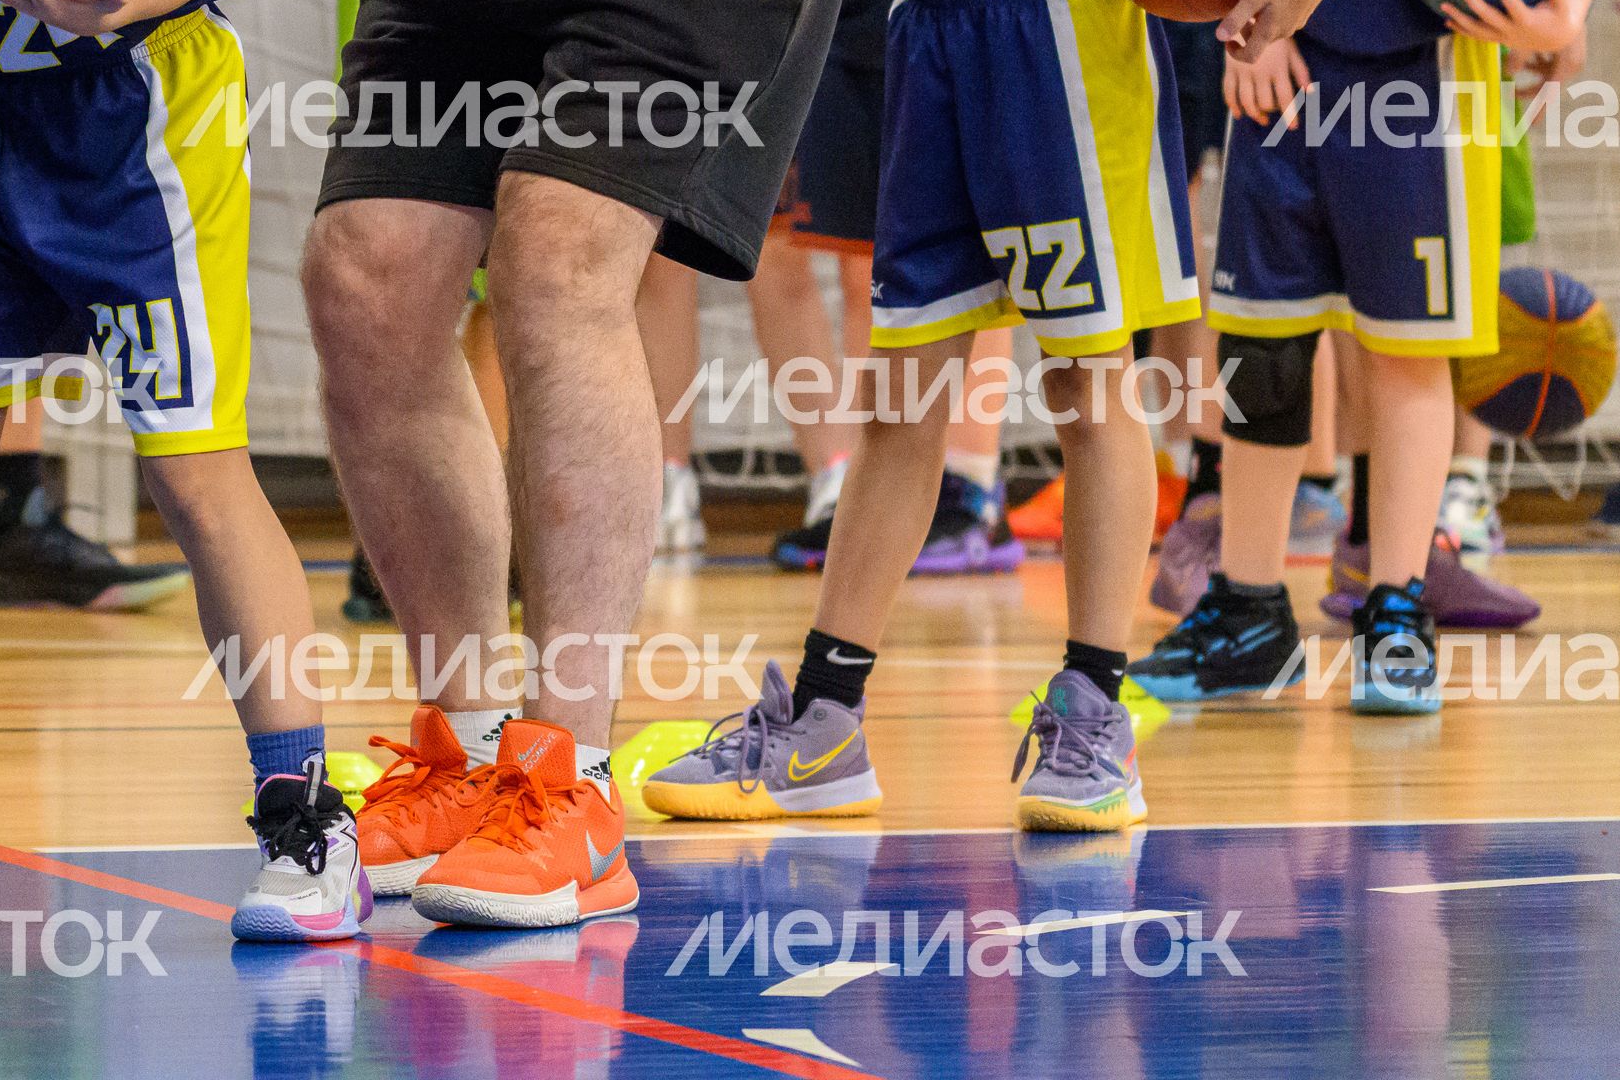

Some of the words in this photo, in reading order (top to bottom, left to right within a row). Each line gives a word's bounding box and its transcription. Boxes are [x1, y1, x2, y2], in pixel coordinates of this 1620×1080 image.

[981, 217, 1096, 311] 22
[1413, 236, 1449, 316] 1
[87, 298, 182, 401] 24
